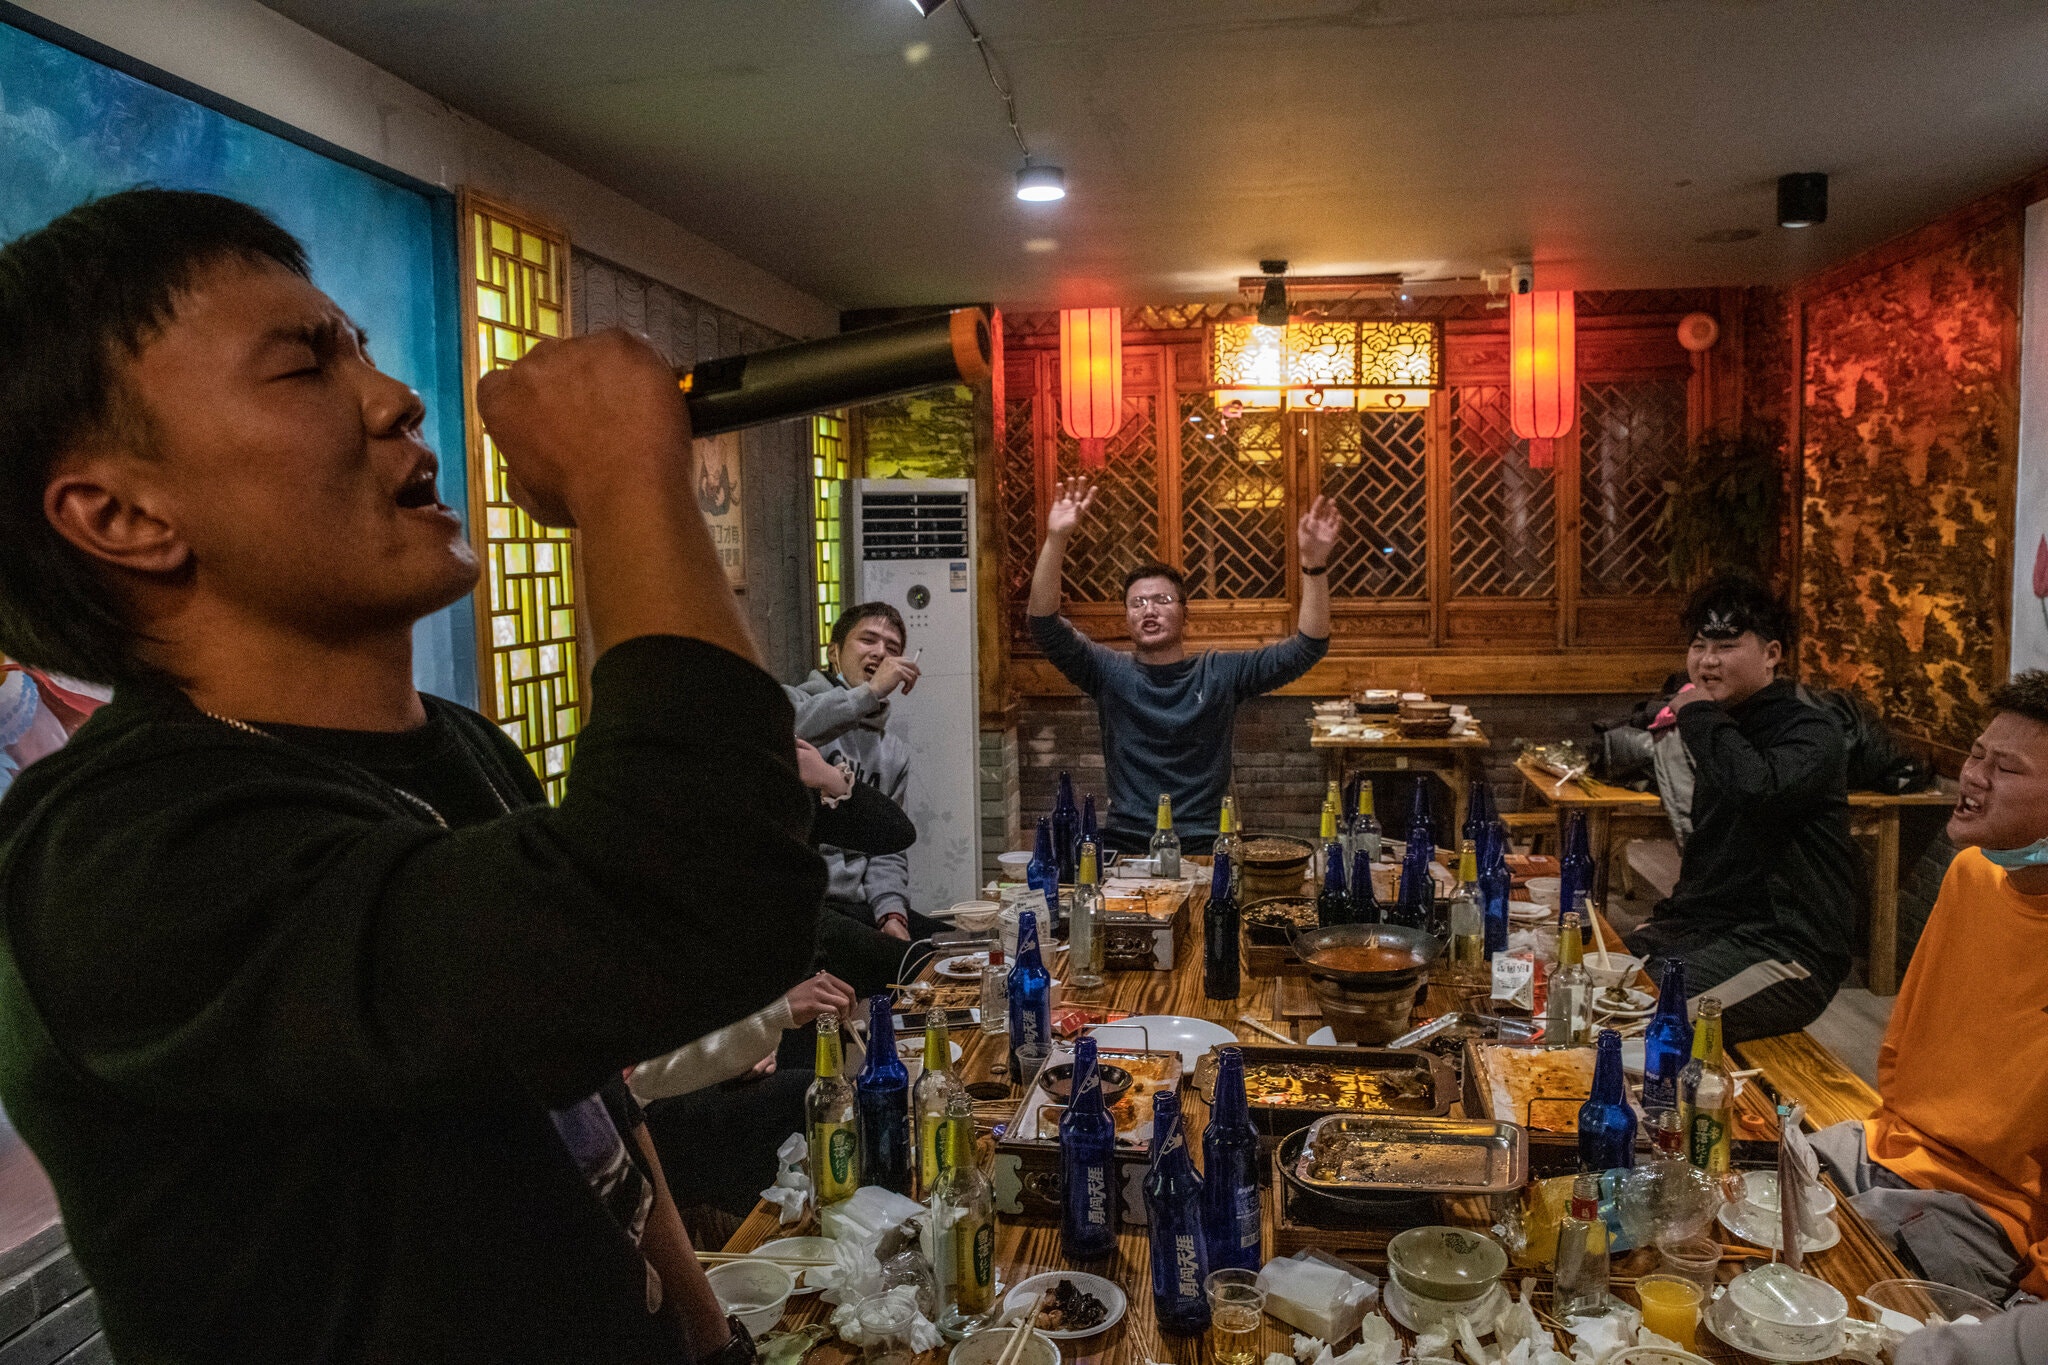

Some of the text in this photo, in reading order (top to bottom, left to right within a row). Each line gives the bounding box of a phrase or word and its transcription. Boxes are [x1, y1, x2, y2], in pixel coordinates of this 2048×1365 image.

[1087, 1166, 1106, 1224] 勇闯天涯
[1175, 1234, 1200, 1297] 勇闯天涯
